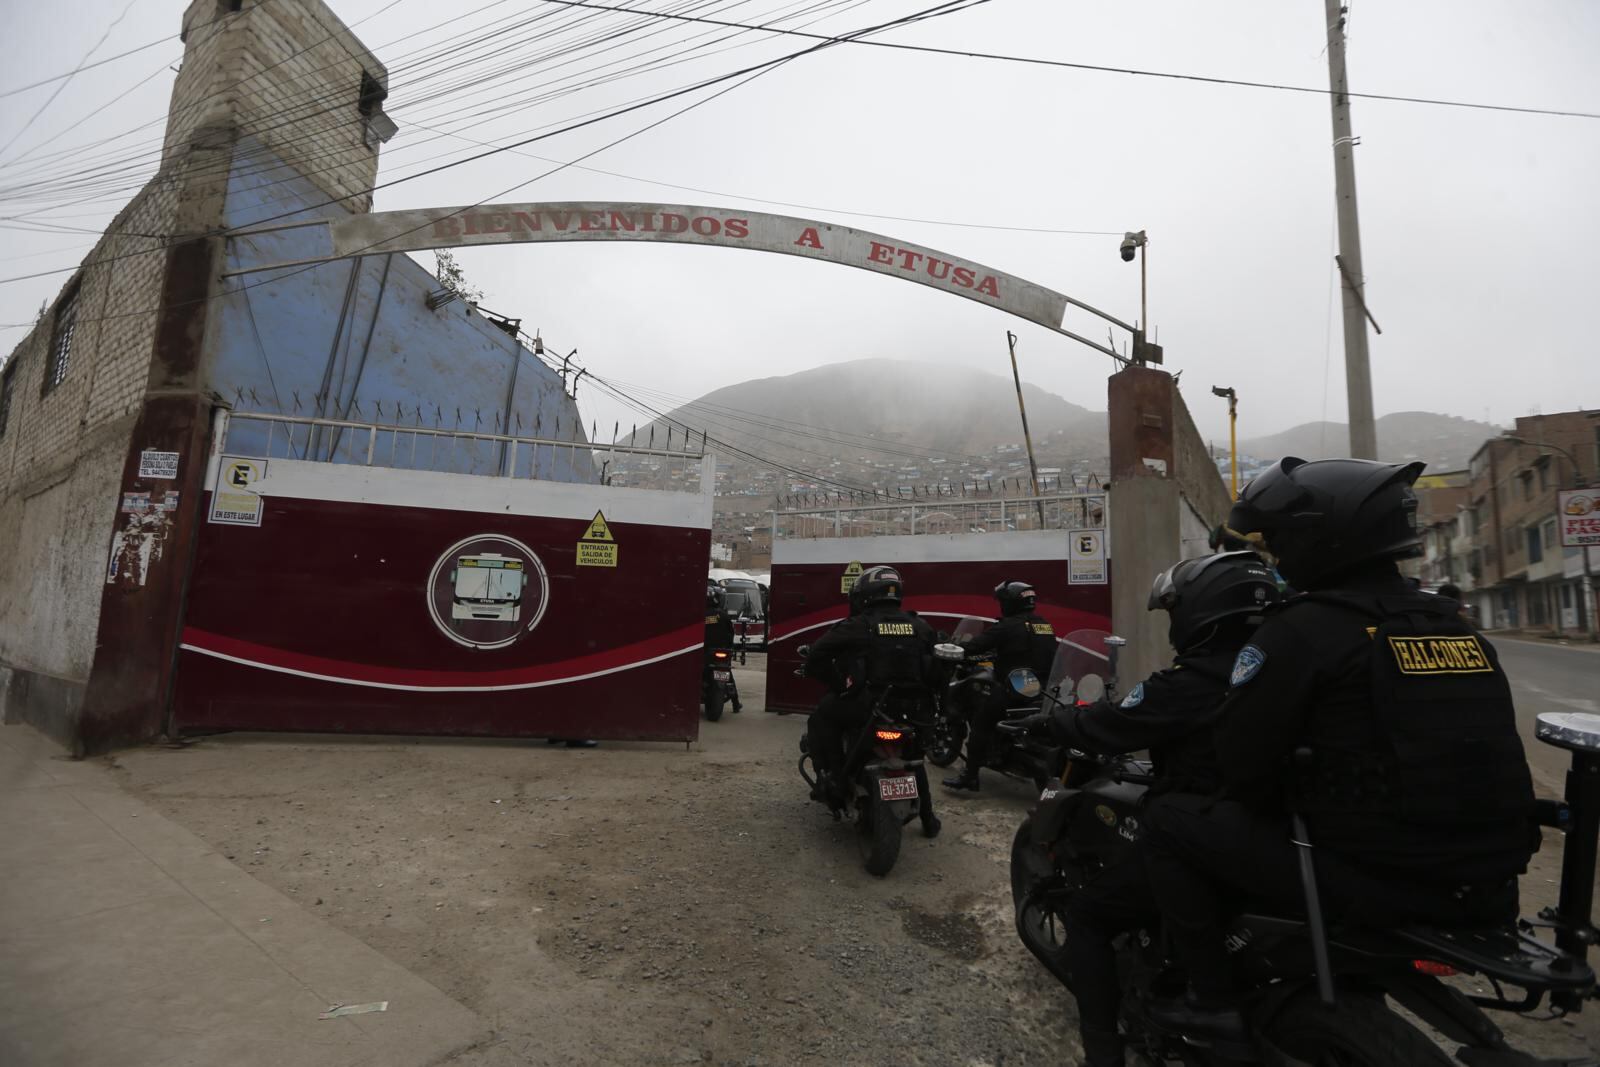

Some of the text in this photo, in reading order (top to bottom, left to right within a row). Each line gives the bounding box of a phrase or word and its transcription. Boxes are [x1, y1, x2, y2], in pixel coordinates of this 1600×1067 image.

[431, 210, 1001, 298] BIENVENIDOS A ETUSA
[215, 510, 256, 520] EN ESTE LUGAR
[1567, 519, 1600, 527] PIZ
[878, 623, 914, 635] HALCONES
[1394, 640, 1484, 669] HALCONES
[881, 782, 915, 796] EU-3713
